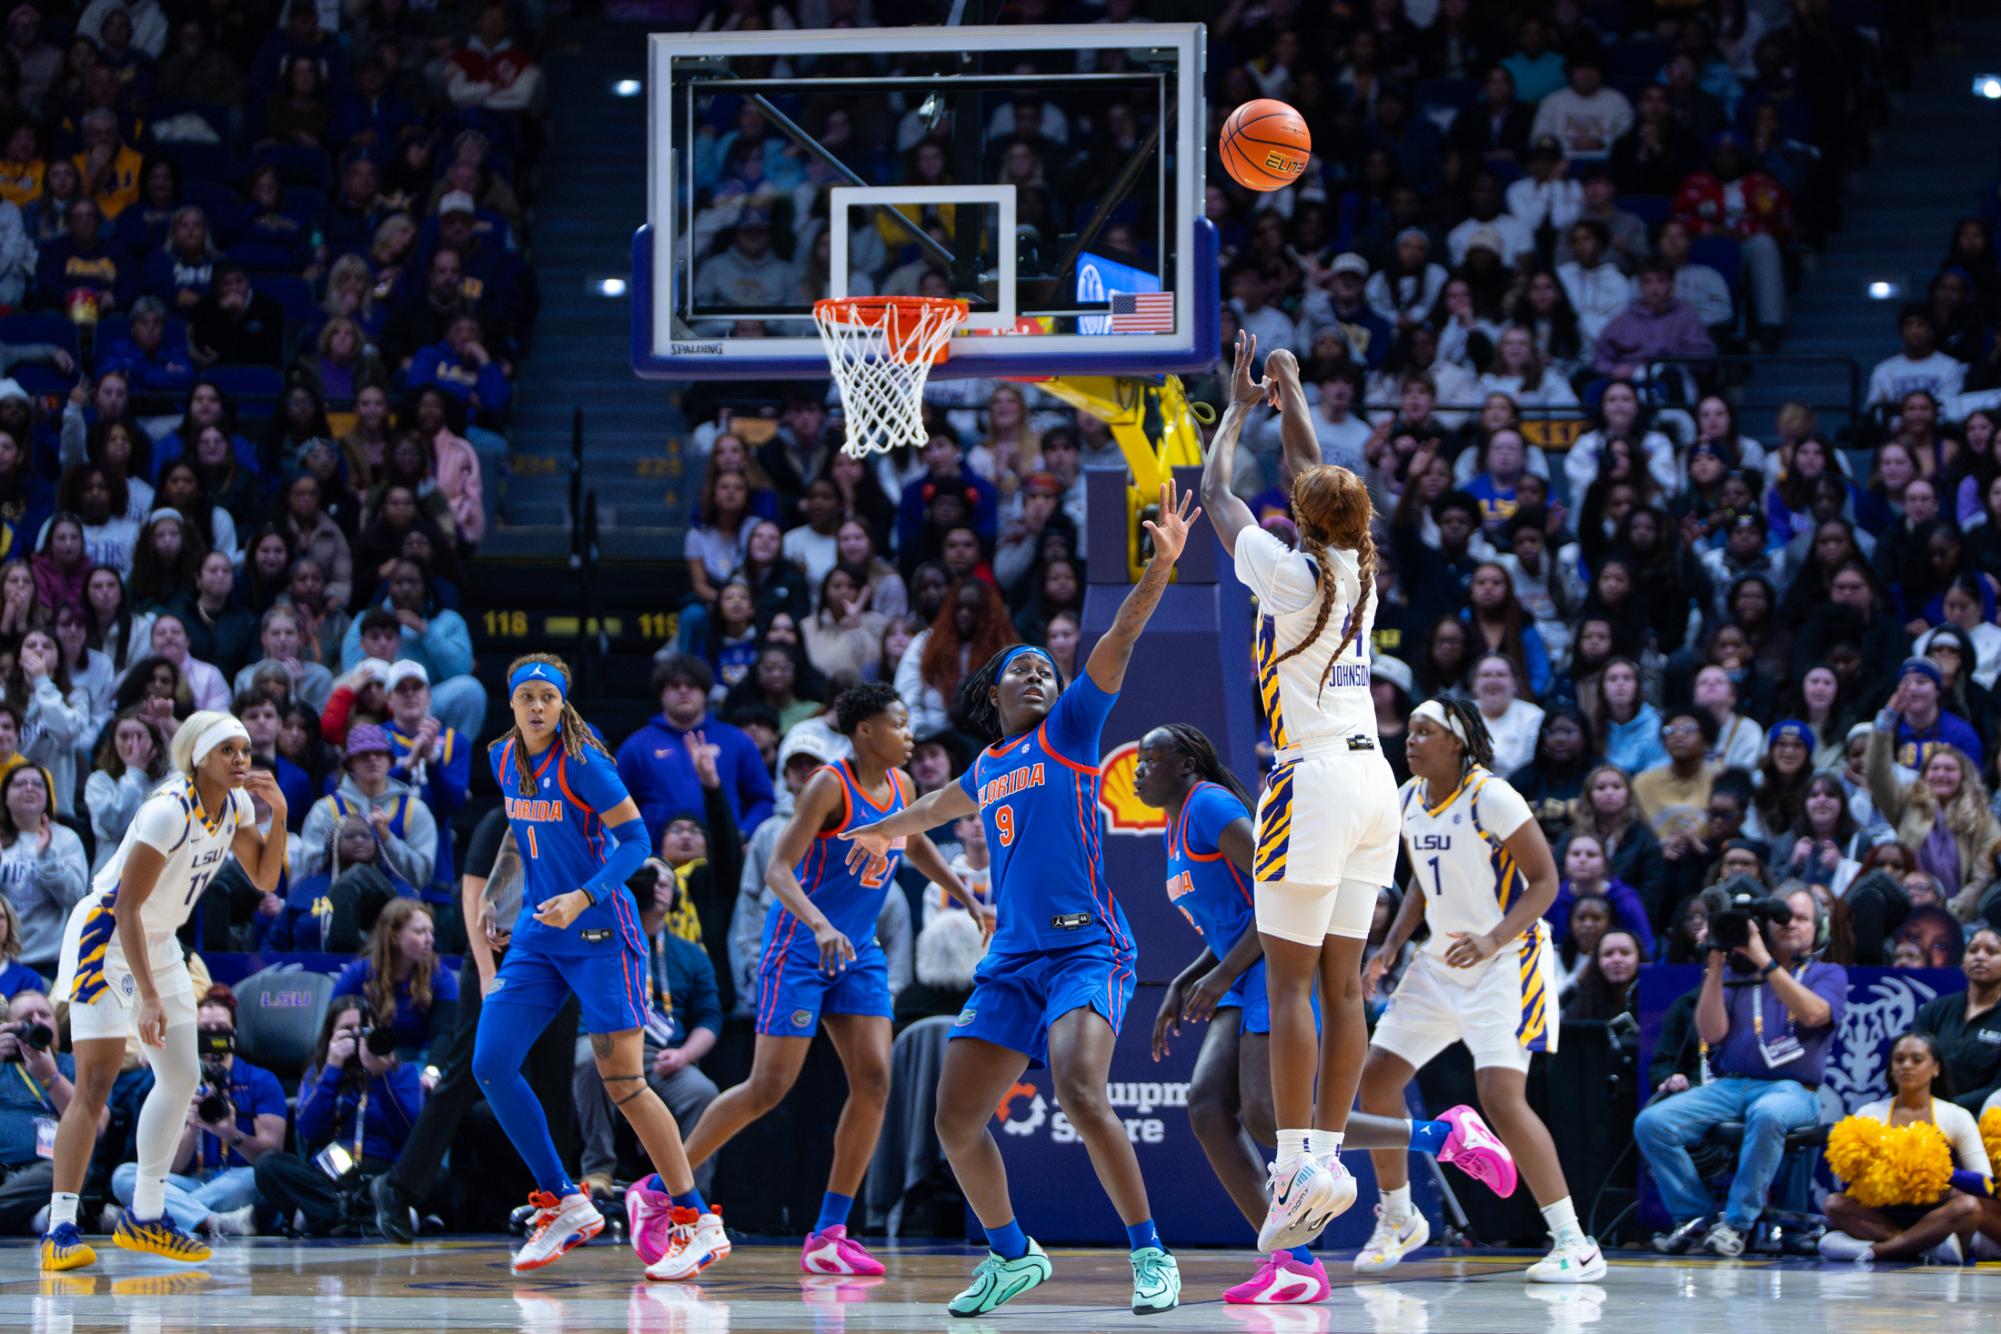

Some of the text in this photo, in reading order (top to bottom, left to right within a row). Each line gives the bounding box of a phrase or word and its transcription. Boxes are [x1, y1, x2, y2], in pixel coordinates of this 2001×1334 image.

[1264, 153, 1305, 174] ELITE
[671, 343, 722, 355] SPALDING
[484, 610, 528, 637] 118
[1341, 603, 1363, 657] 4
[1329, 664, 1370, 687] JOHNSON
[995, 804, 1015, 848] 9
[527, 825, 538, 859] 1
[1414, 834, 1451, 850] LSU
[191, 846, 224, 868] LSU
[184, 870, 211, 906] 11
[1427, 855, 1442, 896] 1
[261, 991, 311, 1008] LSU
[1051, 1111, 1165, 1143] Sre
